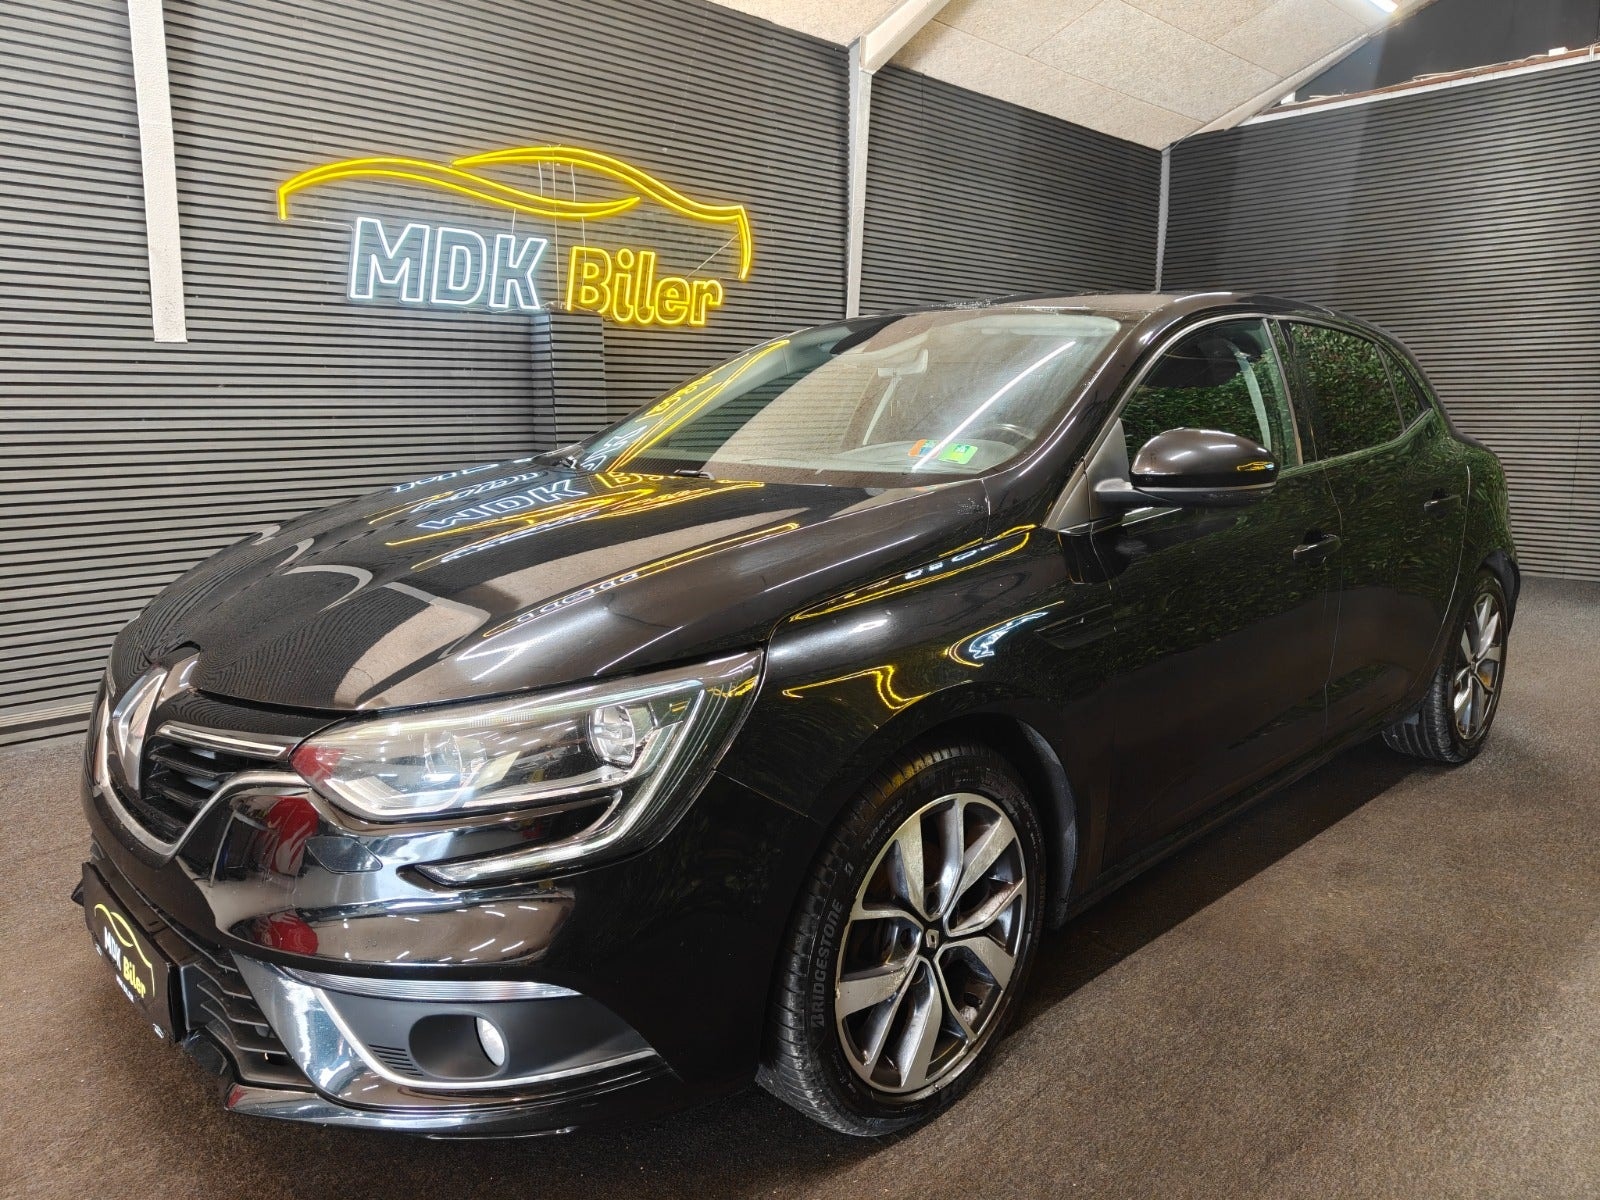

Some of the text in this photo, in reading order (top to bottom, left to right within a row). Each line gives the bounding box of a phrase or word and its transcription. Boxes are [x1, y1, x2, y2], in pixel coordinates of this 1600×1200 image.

[349, 216, 724, 327] MDK Biler
[122, 956, 146, 998] Biler
[811, 898, 843, 1028] BRIDGESTONE
